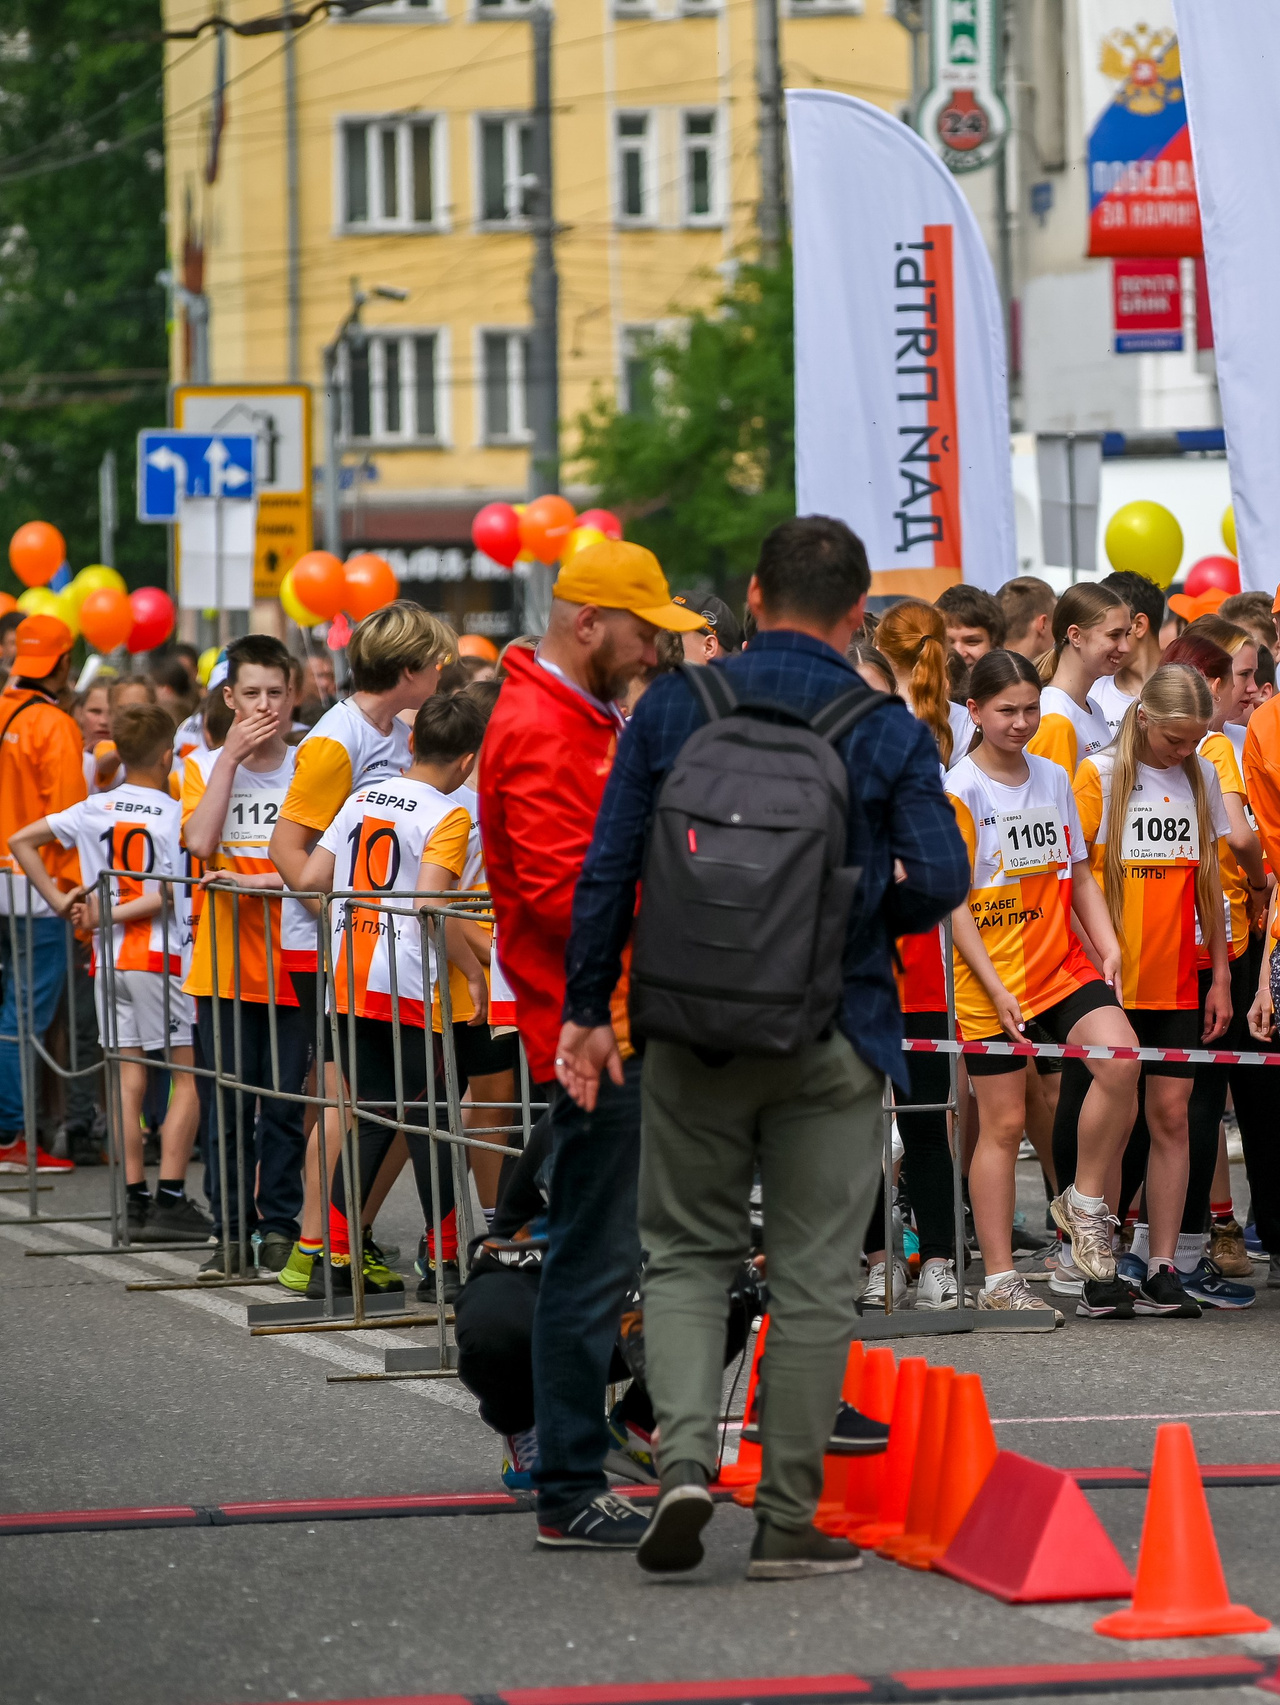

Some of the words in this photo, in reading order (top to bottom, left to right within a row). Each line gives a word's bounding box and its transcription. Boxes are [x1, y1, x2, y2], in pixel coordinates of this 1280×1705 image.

[115, 801, 163, 816] ЕВРАЗ
[366, 791, 418, 812] ЕВРАЗ
[232, 802, 281, 825] 112
[1008, 821, 1057, 850] 1105
[1132, 817, 1191, 842] 1082
[99, 826, 155, 881] 10
[347, 822, 401, 891] 10
[1131, 868, 1167, 880] ПЯТЬ!
[971, 902, 982, 912] 10
[984, 898, 1017, 911] ЗАБЕГ
[361, 919, 402, 940] ПЯТ!
[974, 912, 1003, 931] ДАЙ
